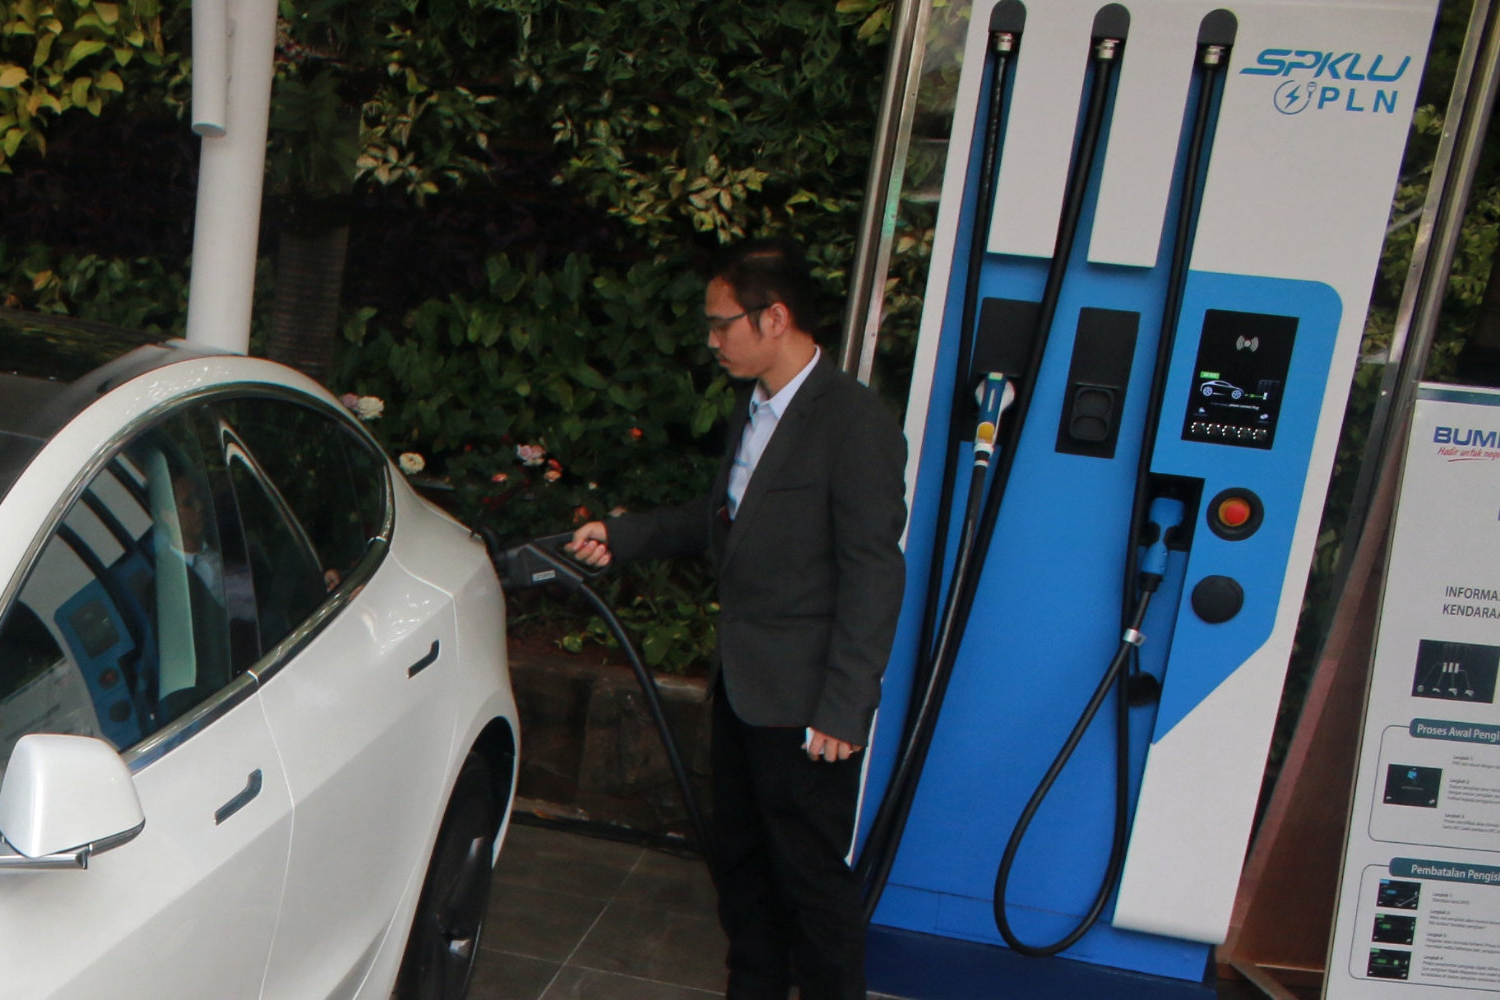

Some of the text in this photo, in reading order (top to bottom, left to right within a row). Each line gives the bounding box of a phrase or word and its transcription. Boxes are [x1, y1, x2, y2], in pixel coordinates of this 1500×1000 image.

[1239, 48, 1411, 82] SPKLU
[1317, 86, 1398, 114] PLN
[1445, 586, 1500, 601] INFORMA
[1417, 723, 1447, 736] Proses
[1448, 726, 1471, 738] Awal
[1411, 864, 1466, 879] Pembatalan
